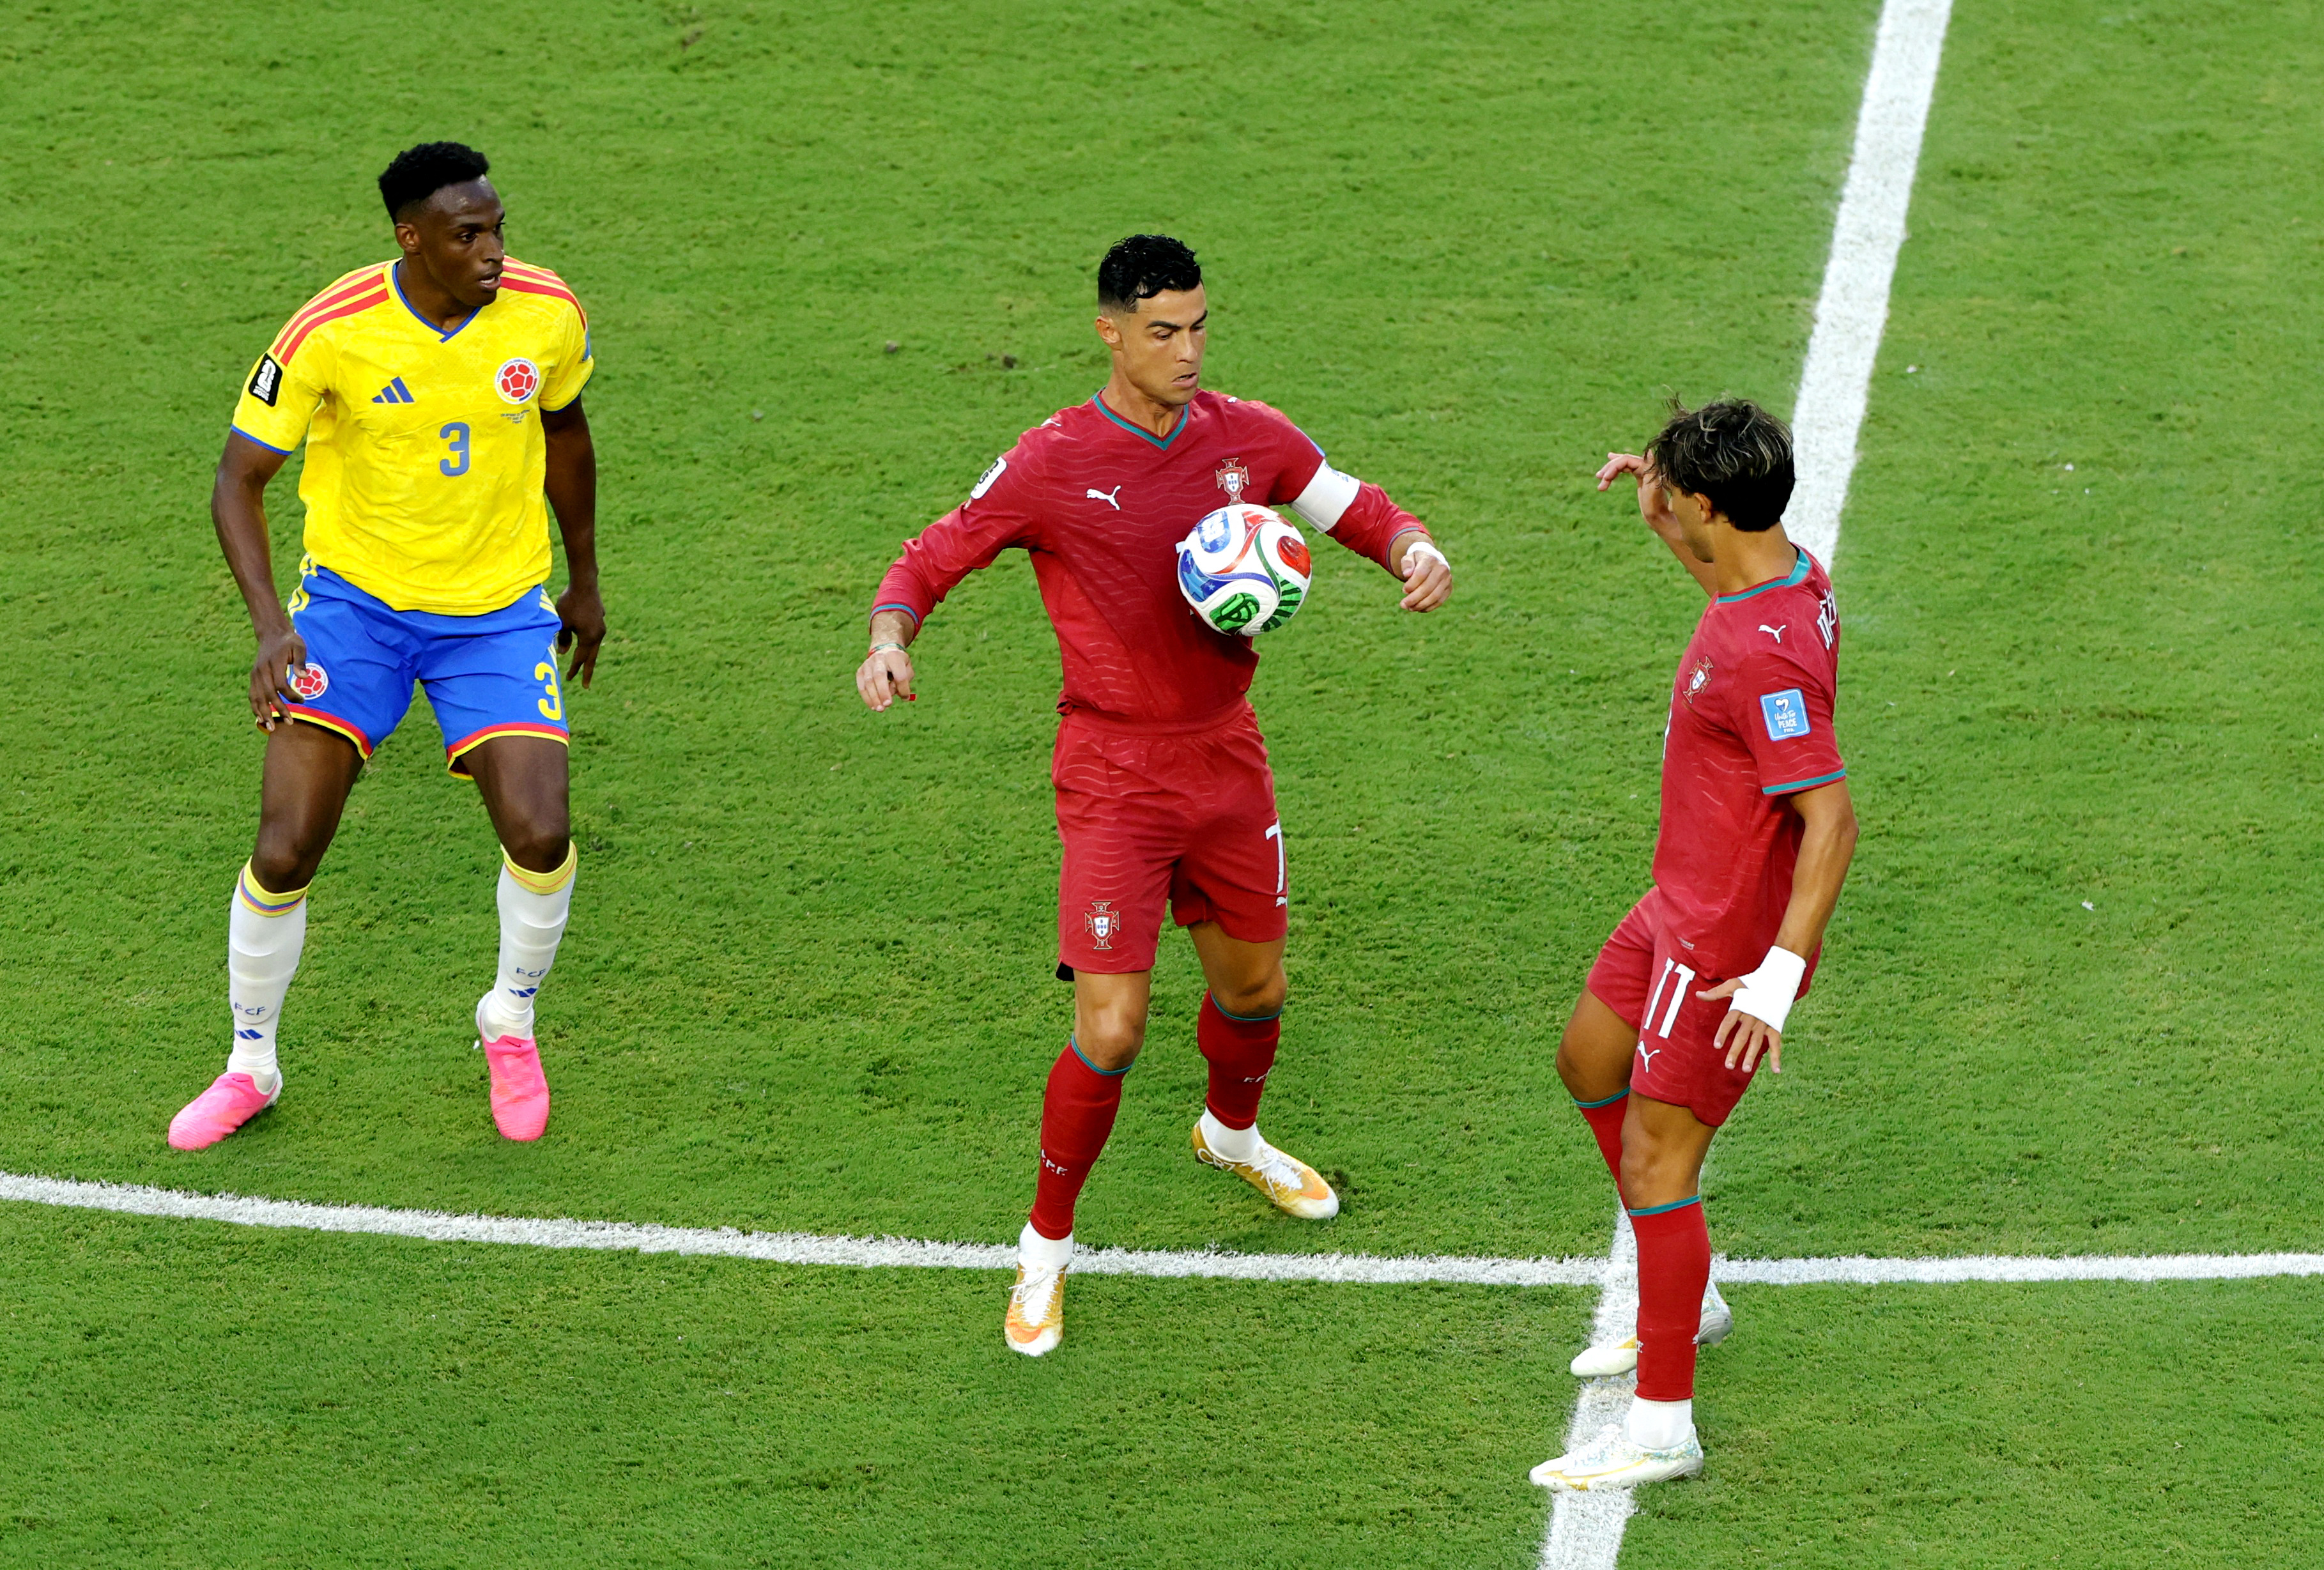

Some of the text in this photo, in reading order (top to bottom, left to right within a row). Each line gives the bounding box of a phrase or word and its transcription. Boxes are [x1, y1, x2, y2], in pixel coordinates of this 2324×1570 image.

[440, 422, 470, 477] 3
[534, 661, 562, 721] 3
[1777, 718, 1797, 728] PEACE
[516, 967, 546, 977] FCF
[235, 1003, 266, 1015] FCF
[1643, 957, 1695, 1038] 11
